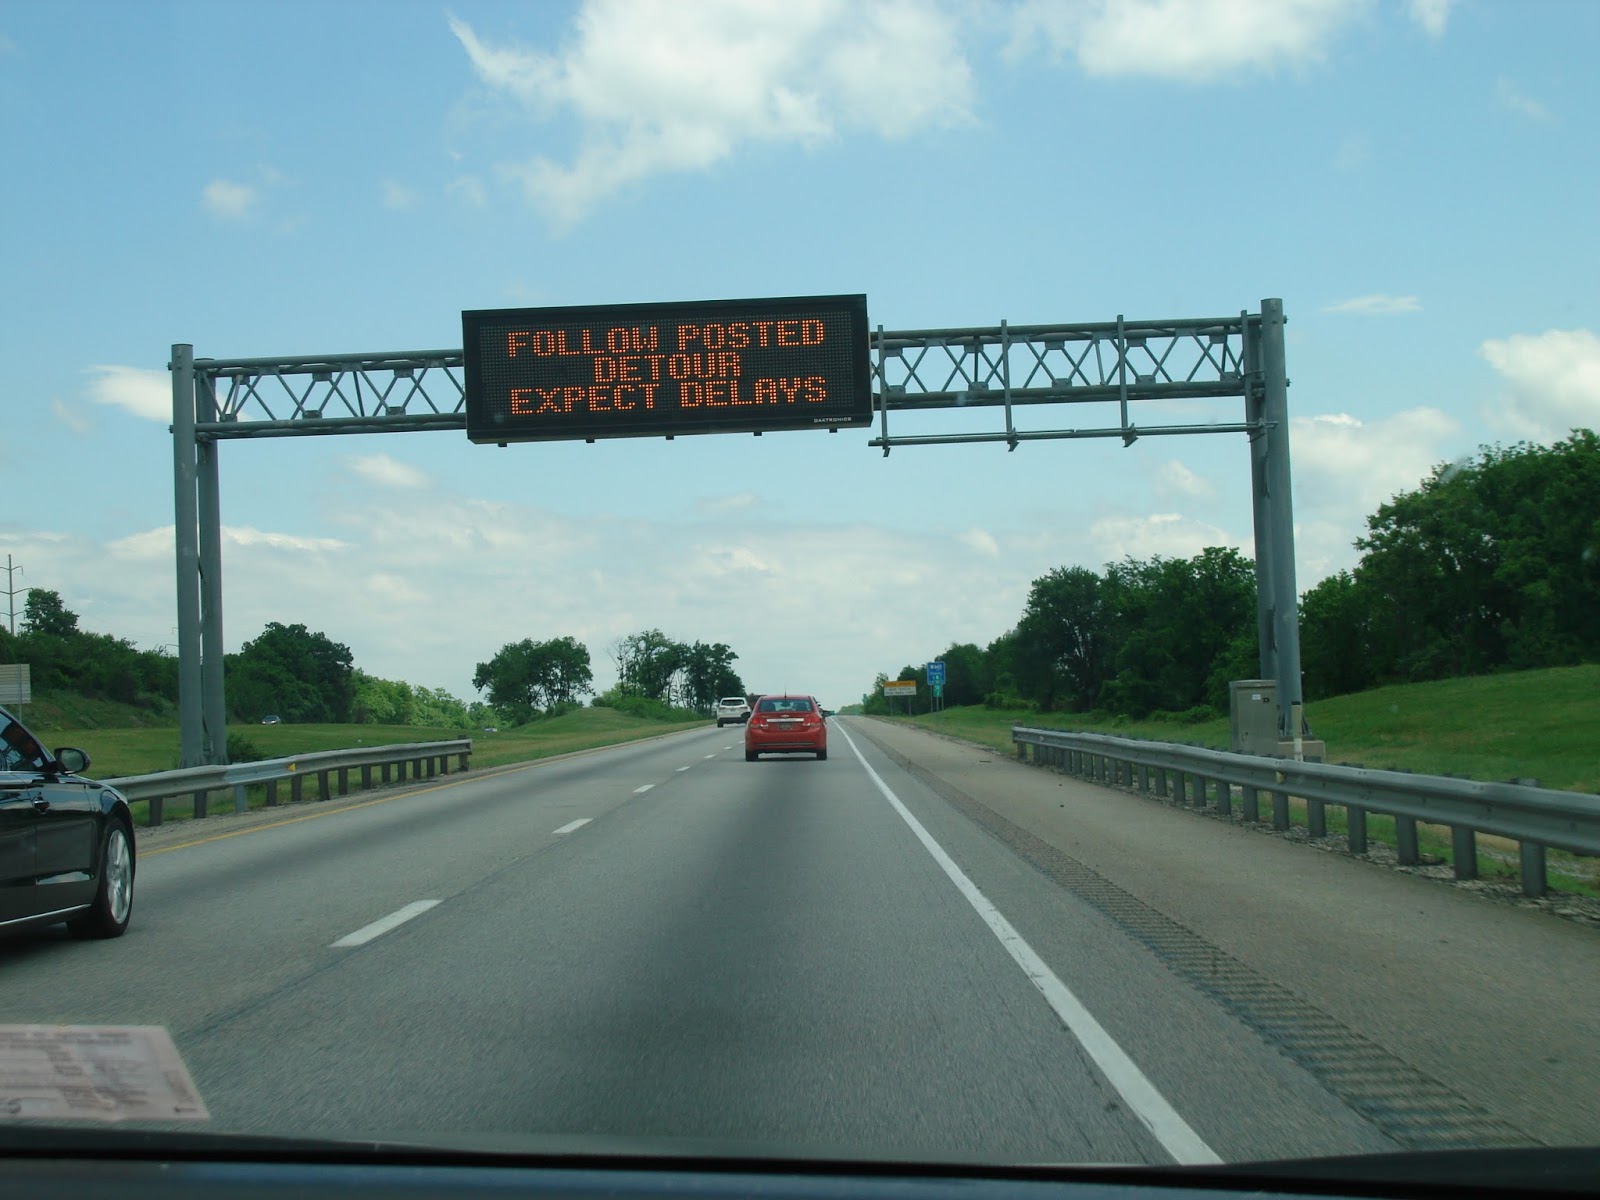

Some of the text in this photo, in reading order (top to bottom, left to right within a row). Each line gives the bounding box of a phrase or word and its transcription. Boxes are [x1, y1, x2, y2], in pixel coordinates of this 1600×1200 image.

[508, 319, 825, 357] FOLLOW POSTED
[593, 352, 741, 382] DETOUR
[511, 376, 826, 415] EXPECT DELAYS
